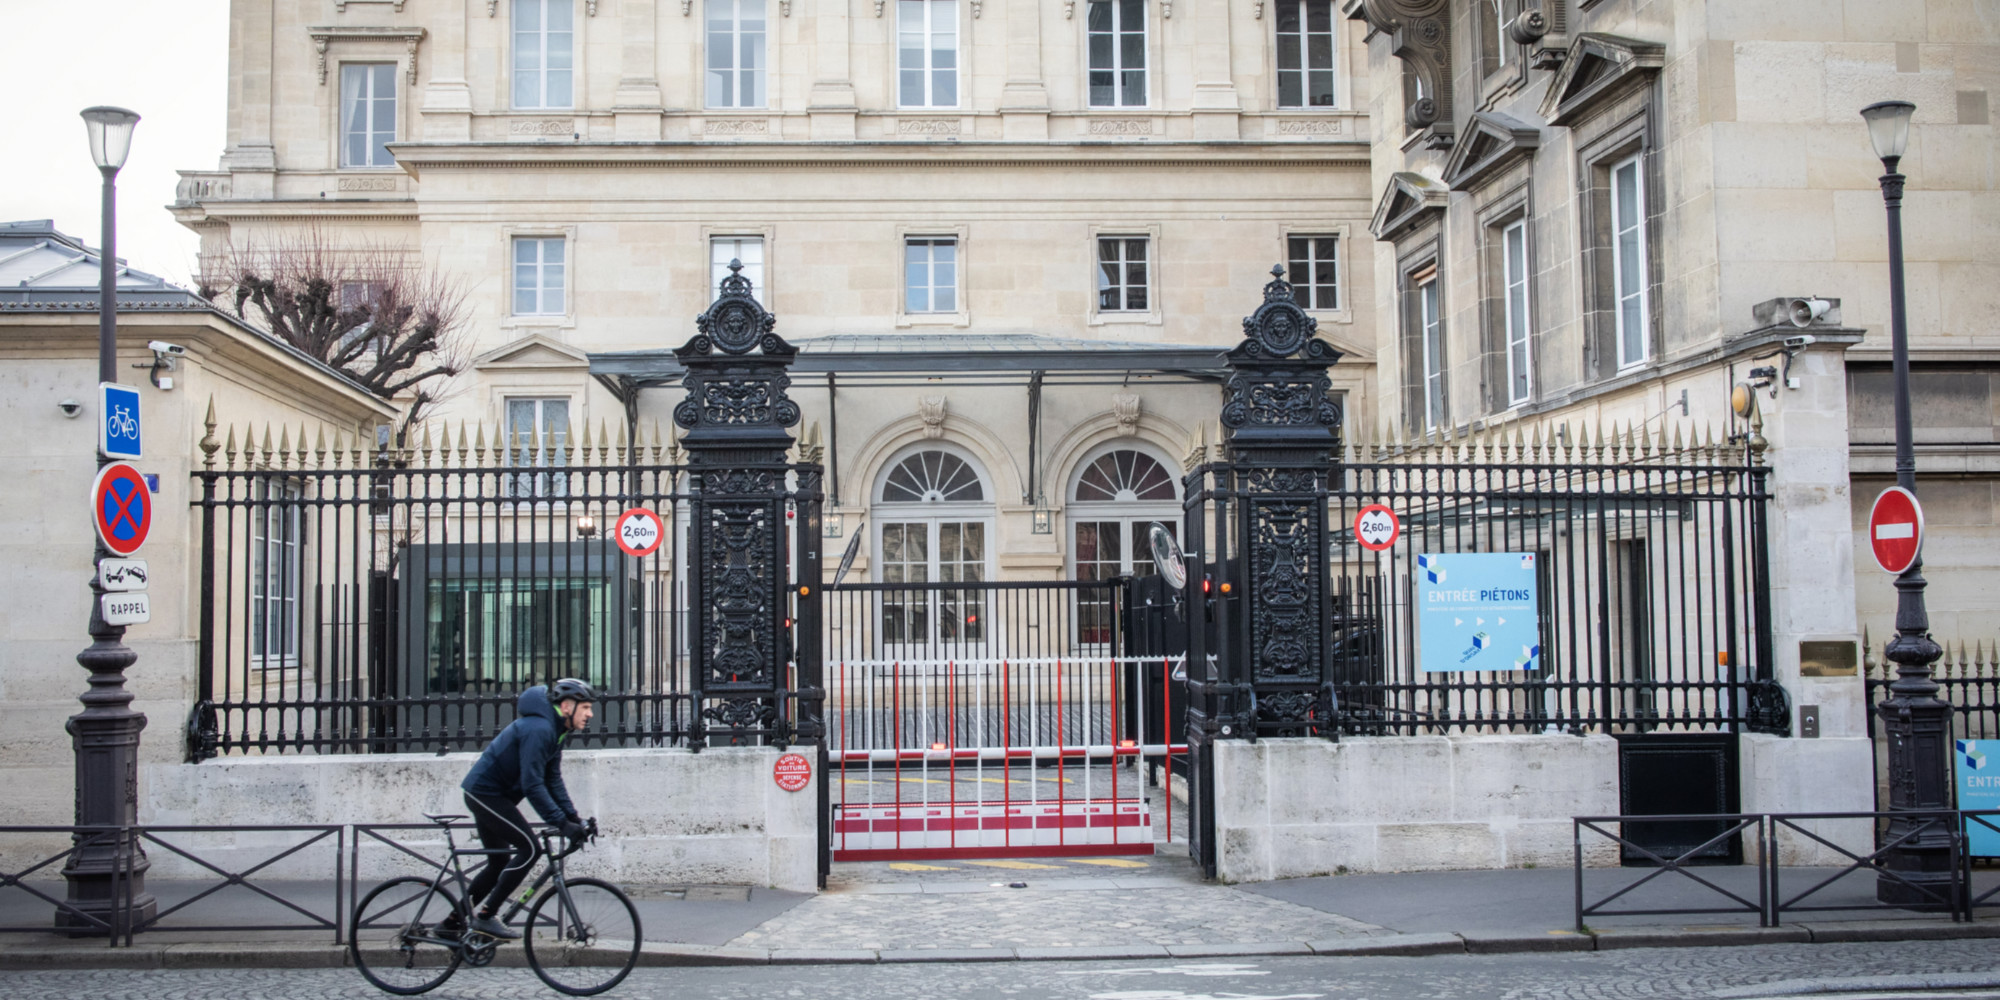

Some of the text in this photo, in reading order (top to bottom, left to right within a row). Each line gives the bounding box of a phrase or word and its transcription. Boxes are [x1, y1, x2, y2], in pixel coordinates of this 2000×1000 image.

[1428, 586, 1530, 602] ENTRÉE PIÉTONS
[111, 602, 146, 615] RAPPEL
[780, 756, 804, 765] SORTIE
